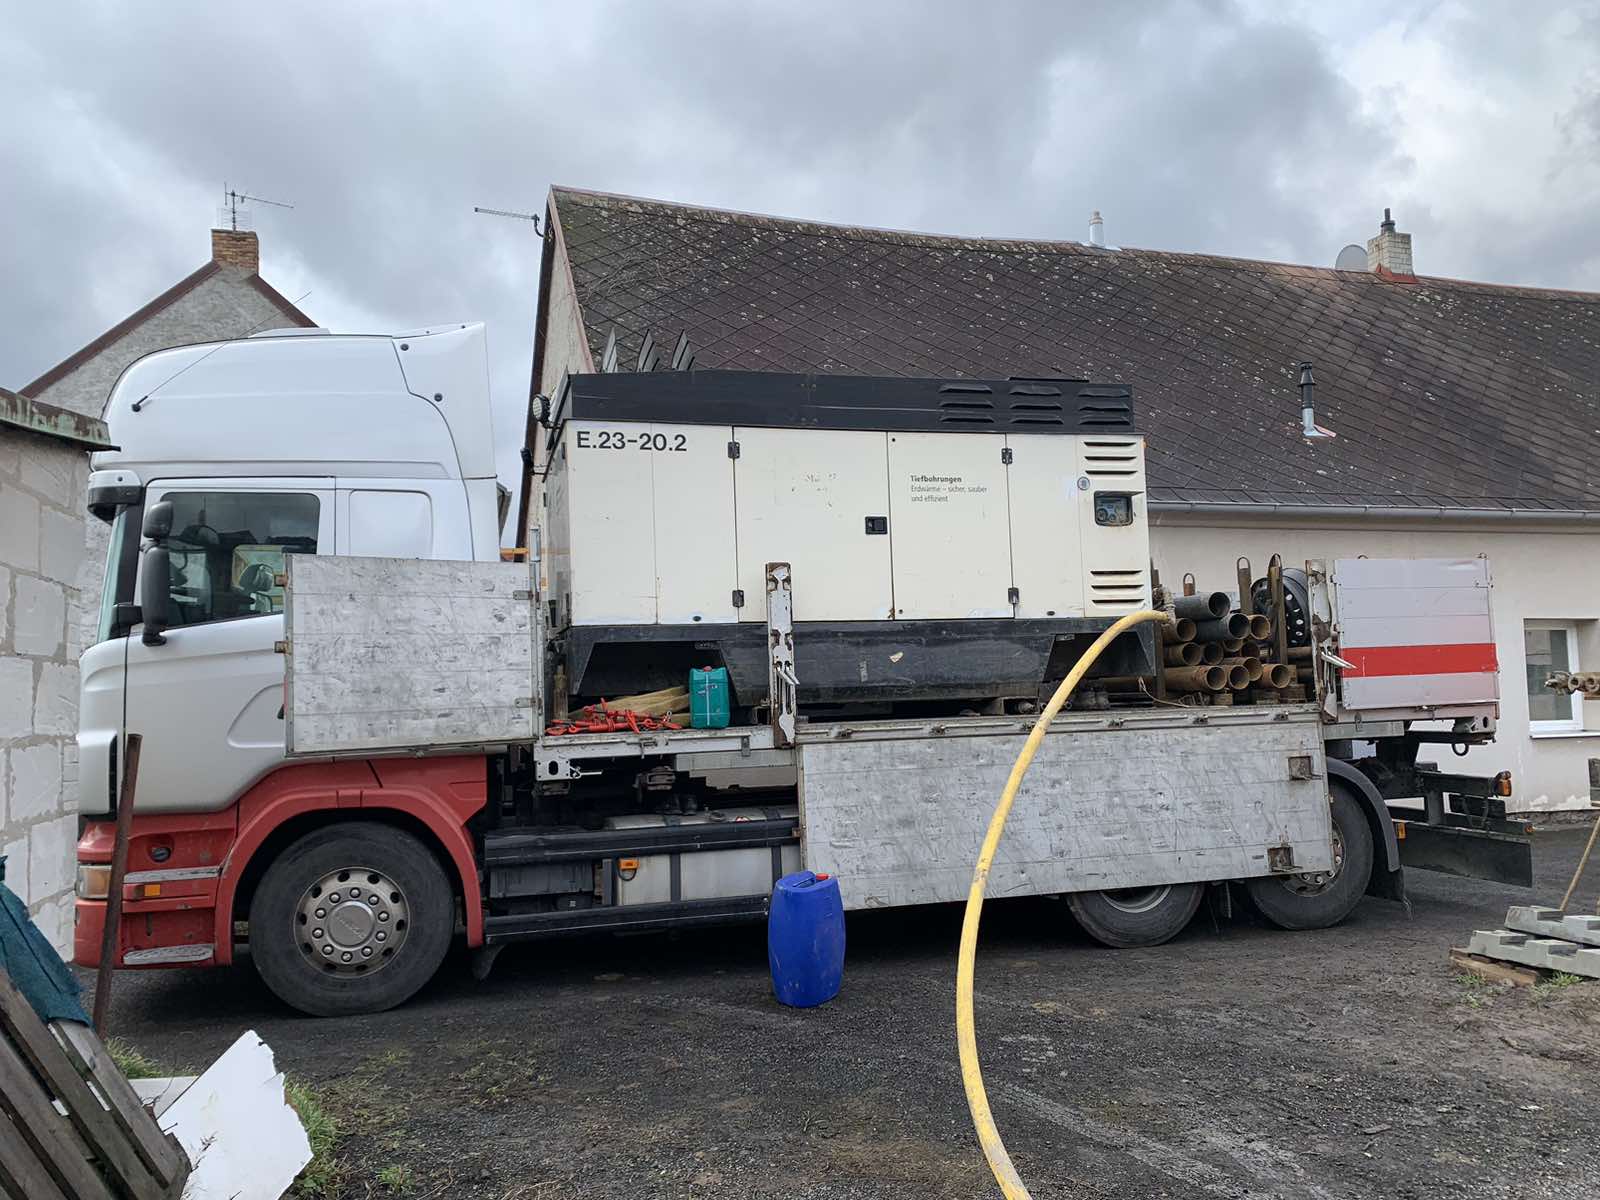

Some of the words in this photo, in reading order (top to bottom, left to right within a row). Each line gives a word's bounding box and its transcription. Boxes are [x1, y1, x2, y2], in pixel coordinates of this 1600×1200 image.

[576, 430, 687, 452] E.23-20.2
[911, 475, 962, 484] Tiefbohrungen
[968, 485, 988, 493] sauber
[924, 495, 948, 503] effizient
